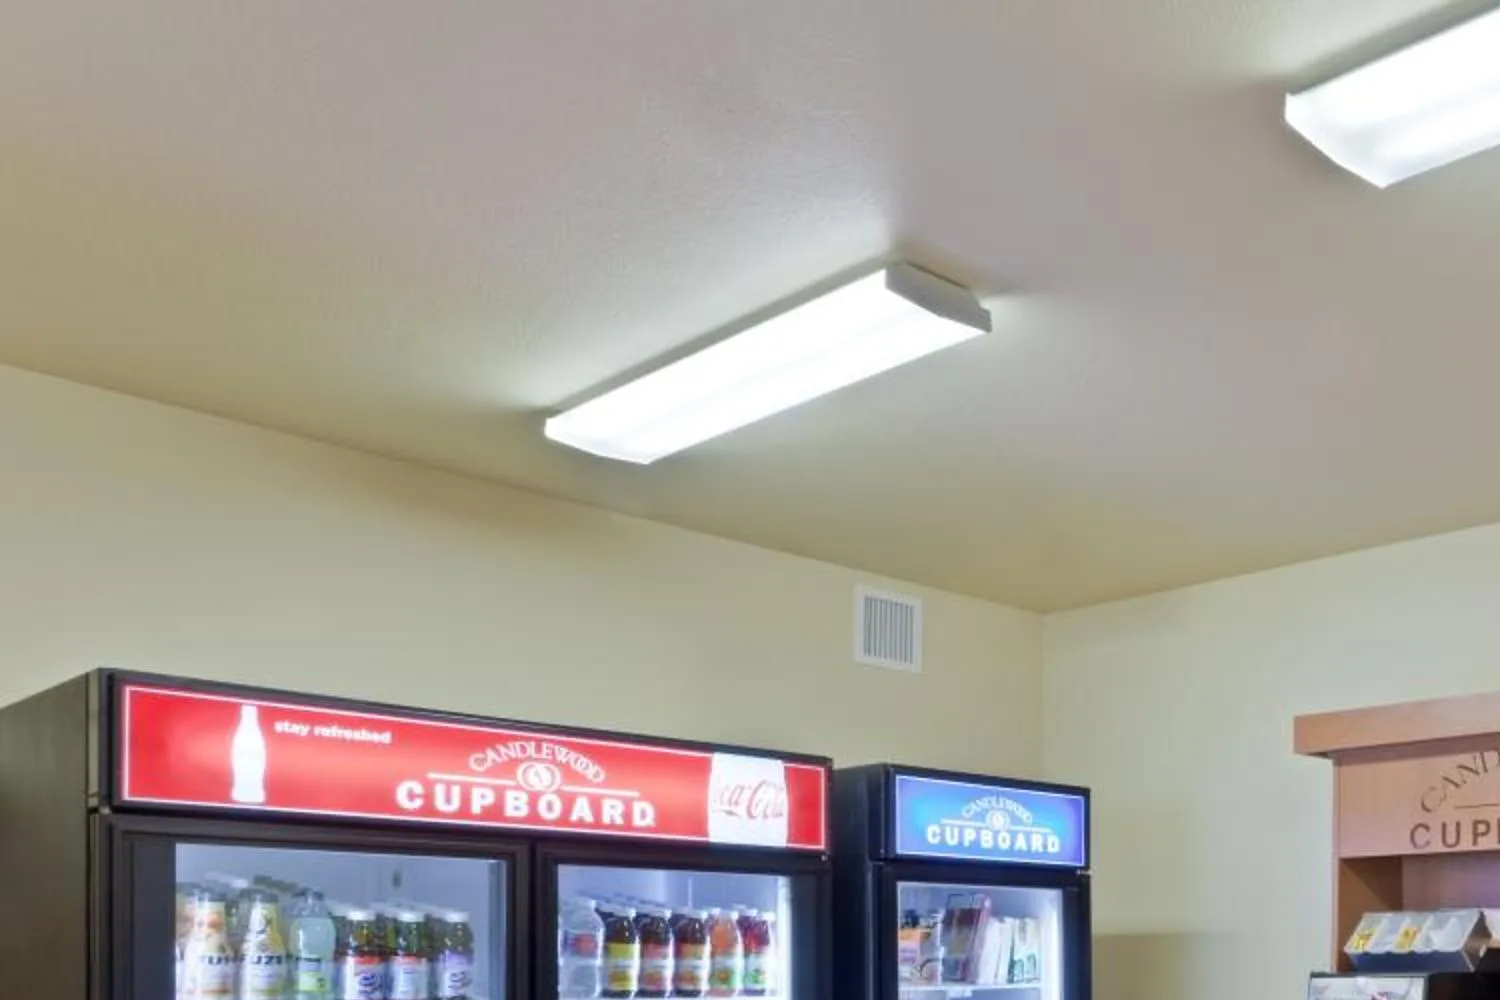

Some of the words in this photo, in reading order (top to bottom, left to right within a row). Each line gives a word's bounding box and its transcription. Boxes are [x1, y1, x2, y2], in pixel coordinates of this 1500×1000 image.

[273, 720, 311, 737] stay
[313, 725, 393, 745] refreshed
[468, 740, 605, 784] CANDLEWOOD
[396, 780, 657, 828] CUPBOARD
[960, 795, 1034, 824] CANDLEWOOD
[926, 824, 1061, 854] CUPBOARD
